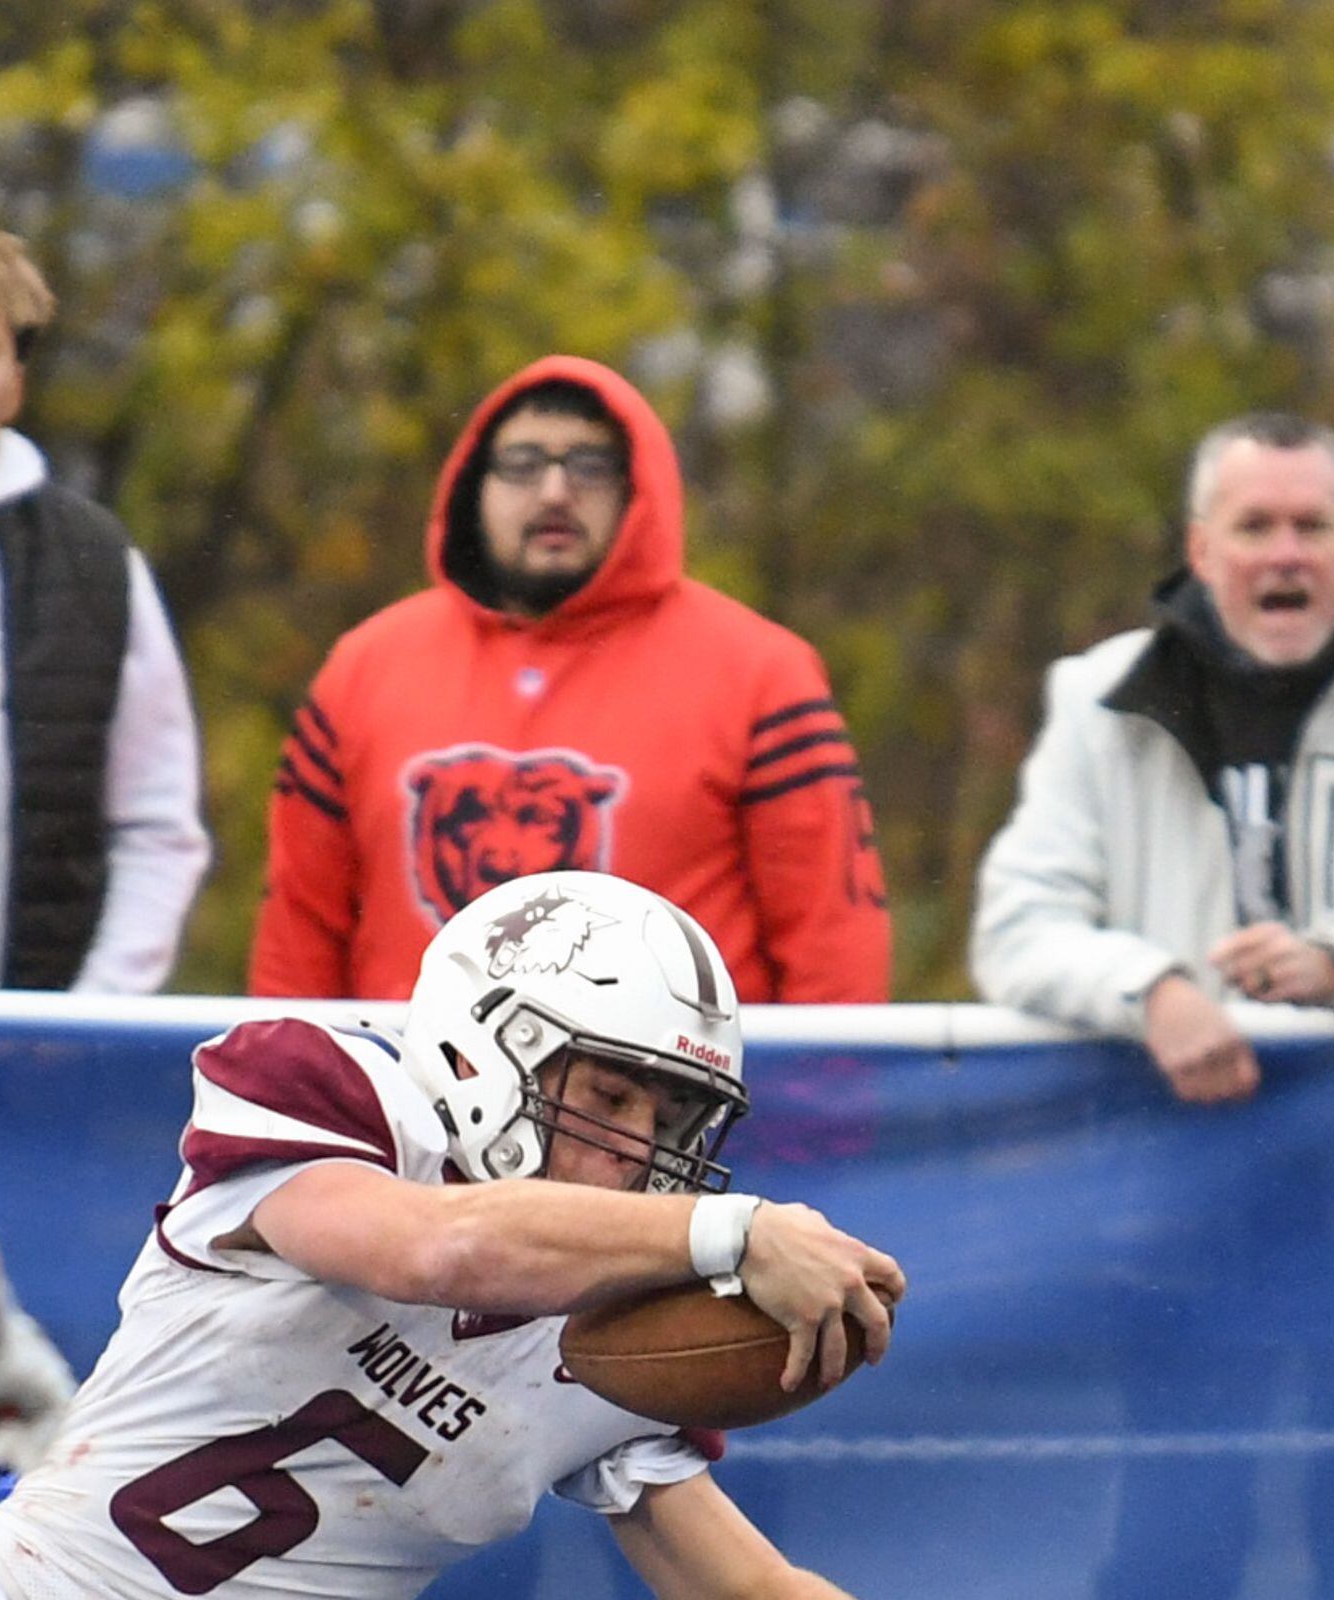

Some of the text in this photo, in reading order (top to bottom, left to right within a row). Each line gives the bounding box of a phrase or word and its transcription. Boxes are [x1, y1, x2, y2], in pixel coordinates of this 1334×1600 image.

[676, 1034, 731, 1070] Riddell
[347, 1322, 487, 1442] WOLVES
[109, 1388, 431, 1596] 6
